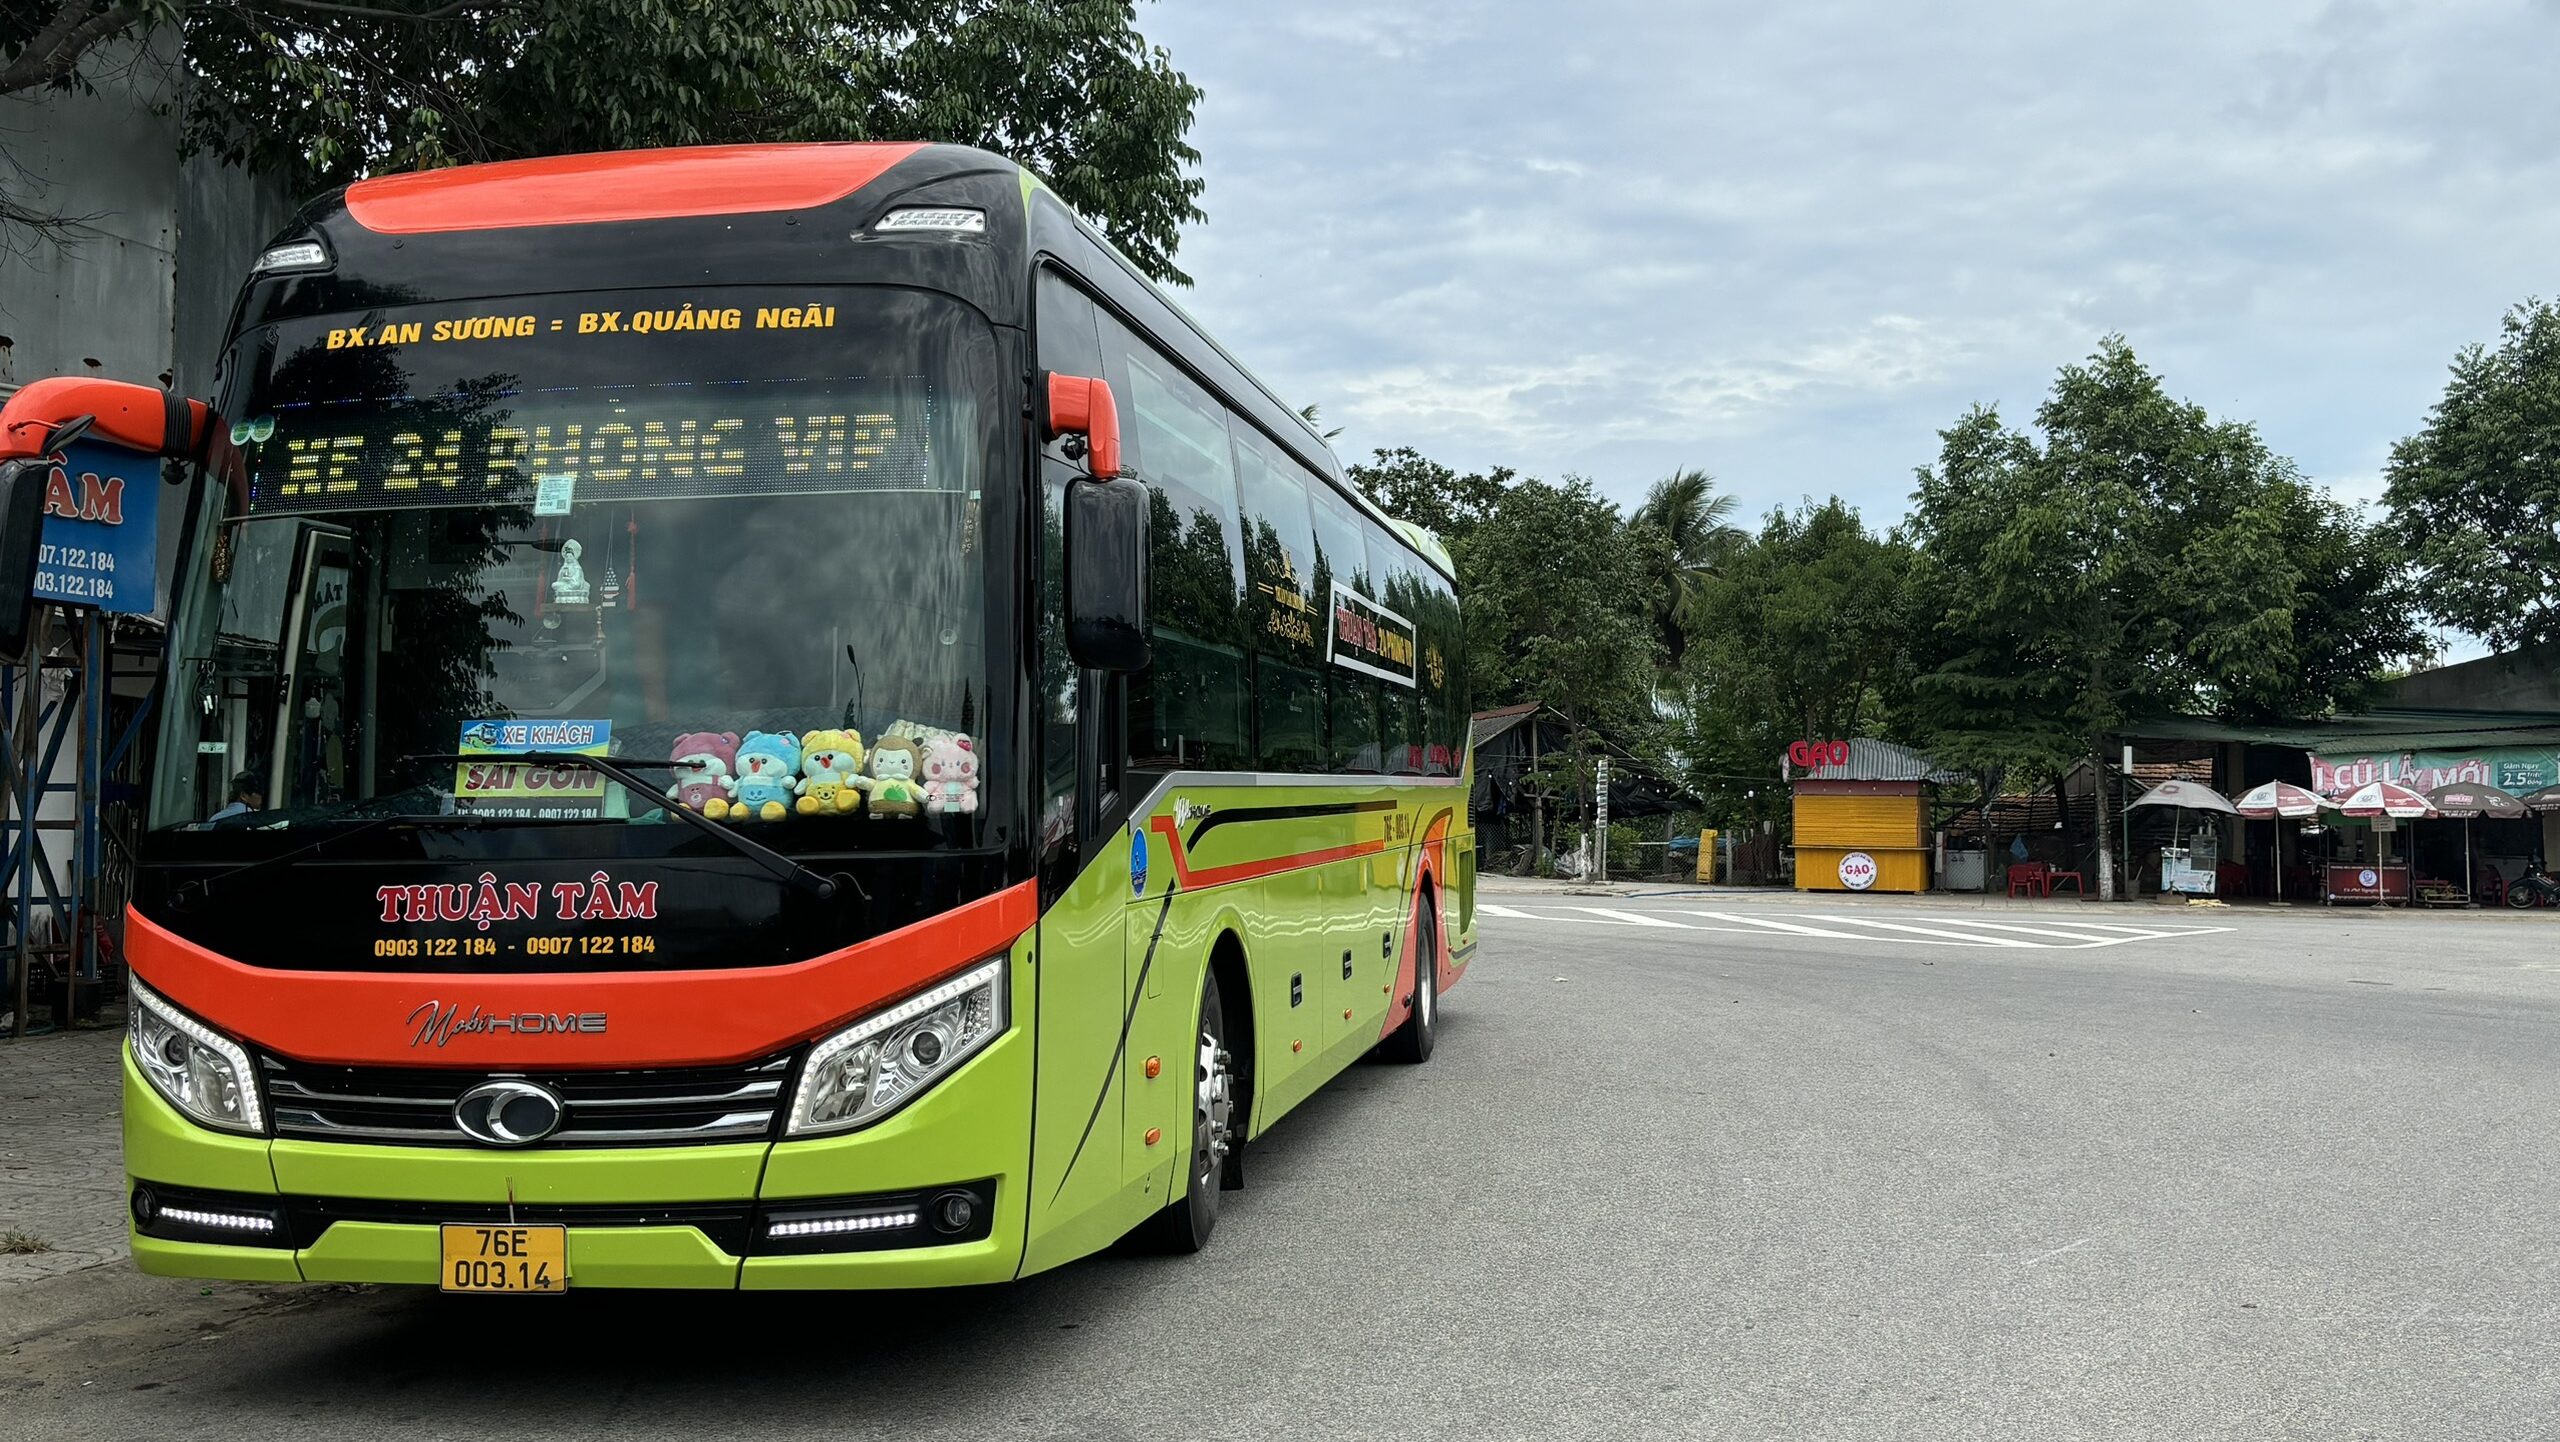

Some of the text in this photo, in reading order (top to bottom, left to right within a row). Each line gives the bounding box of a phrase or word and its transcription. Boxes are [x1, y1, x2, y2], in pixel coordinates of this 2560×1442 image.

[431, 315, 536, 342] SƯƠNG
[756, 303, 836, 329] NGÃI
[281, 399, 897, 495] XE 24 PHÒNG VIP
[502, 721, 594, 745] XE KHÁCH
[1789, 740, 1850, 777] GẠO
[376, 870, 659, 931] THUẬN TÂM
[374, 939, 418, 957] 0903
[424, 939, 457, 956] 122
[463, 938, 497, 956] 184
[526, 937, 573, 955] 0907
[579, 936, 614, 955] 122
[620, 936, 656, 954] 184
[455, 1229, 550, 1289] 76E 003.14
